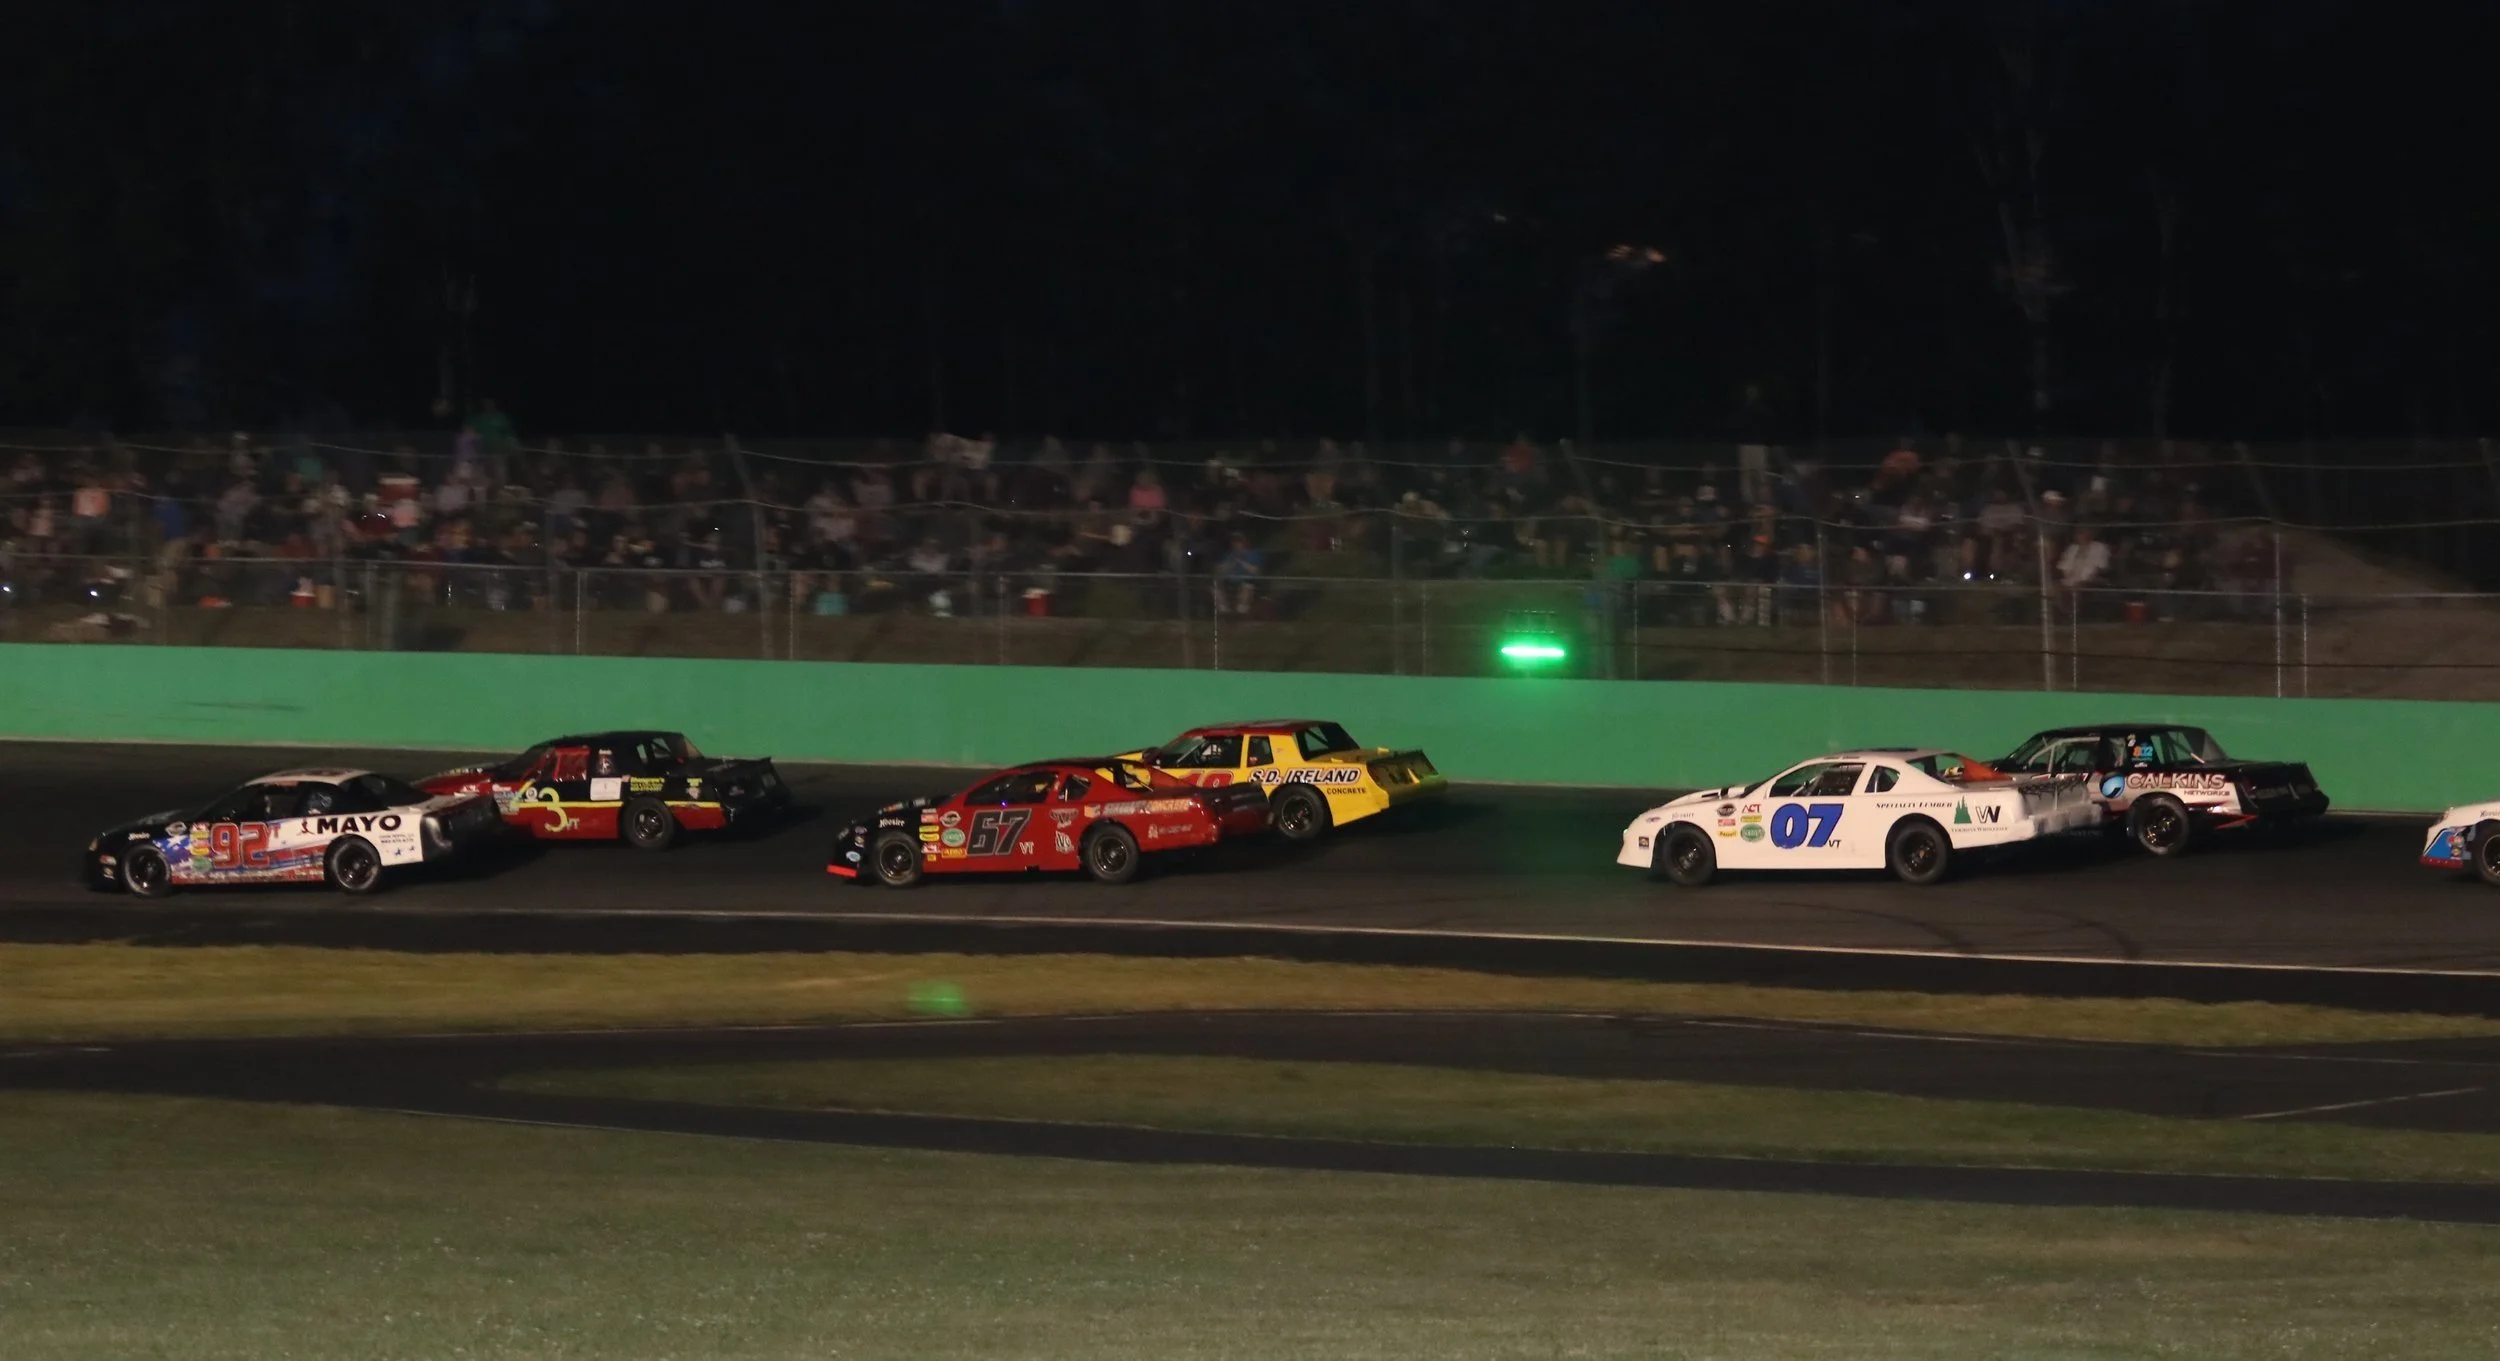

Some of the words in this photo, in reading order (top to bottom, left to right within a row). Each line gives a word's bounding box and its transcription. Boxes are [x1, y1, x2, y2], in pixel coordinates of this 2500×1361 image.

[1249, 768, 1281, 785] S.D.
[1283, 768, 1361, 785] IRELAND
[2126, 772, 2225, 790] CALKINS
[1327, 787, 1366, 795] CONCRETE
[538, 787, 568, 832] 3
[1741, 804, 1761, 814] ACT
[317, 815, 402, 835] MAYO
[966, 808, 1032, 856] 67
[1770, 803, 1844, 849] 07
[210, 821, 271, 869] 92
[1019, 841, 1035, 855] VT
[1828, 839, 1842, 849] VT
